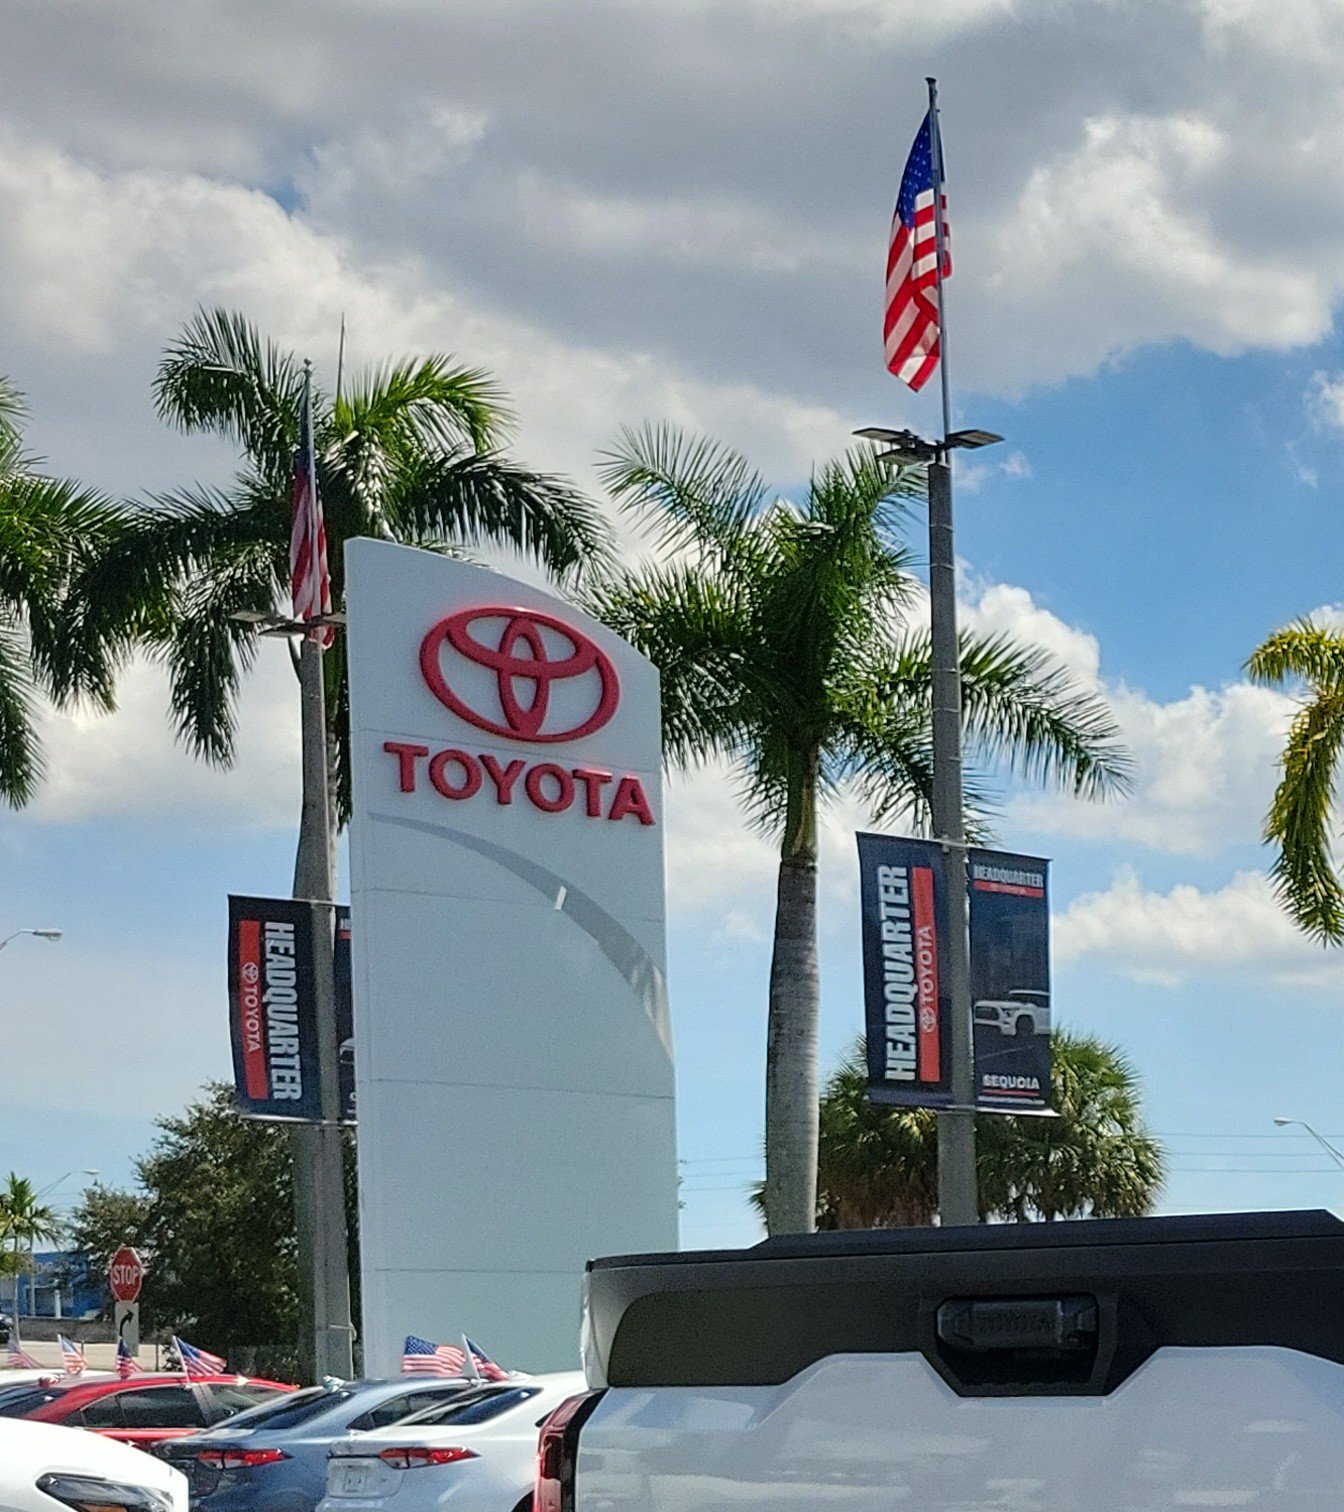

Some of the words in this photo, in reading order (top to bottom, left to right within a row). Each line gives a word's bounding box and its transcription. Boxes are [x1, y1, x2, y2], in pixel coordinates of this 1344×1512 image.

[383, 741, 656, 826] TOYOTA
[973, 864, 1044, 889] HEADQUARTER
[876, 865, 917, 1082] HEADQUARTER
[916, 926, 936, 1003] TOYOTA
[243, 985, 261, 1052] TOYOTA
[262, 921, 303, 1101] HEADQUARTER
[982, 1072, 1040, 1091] SEQUOIA
[112, 1264, 141, 1285] STOP
